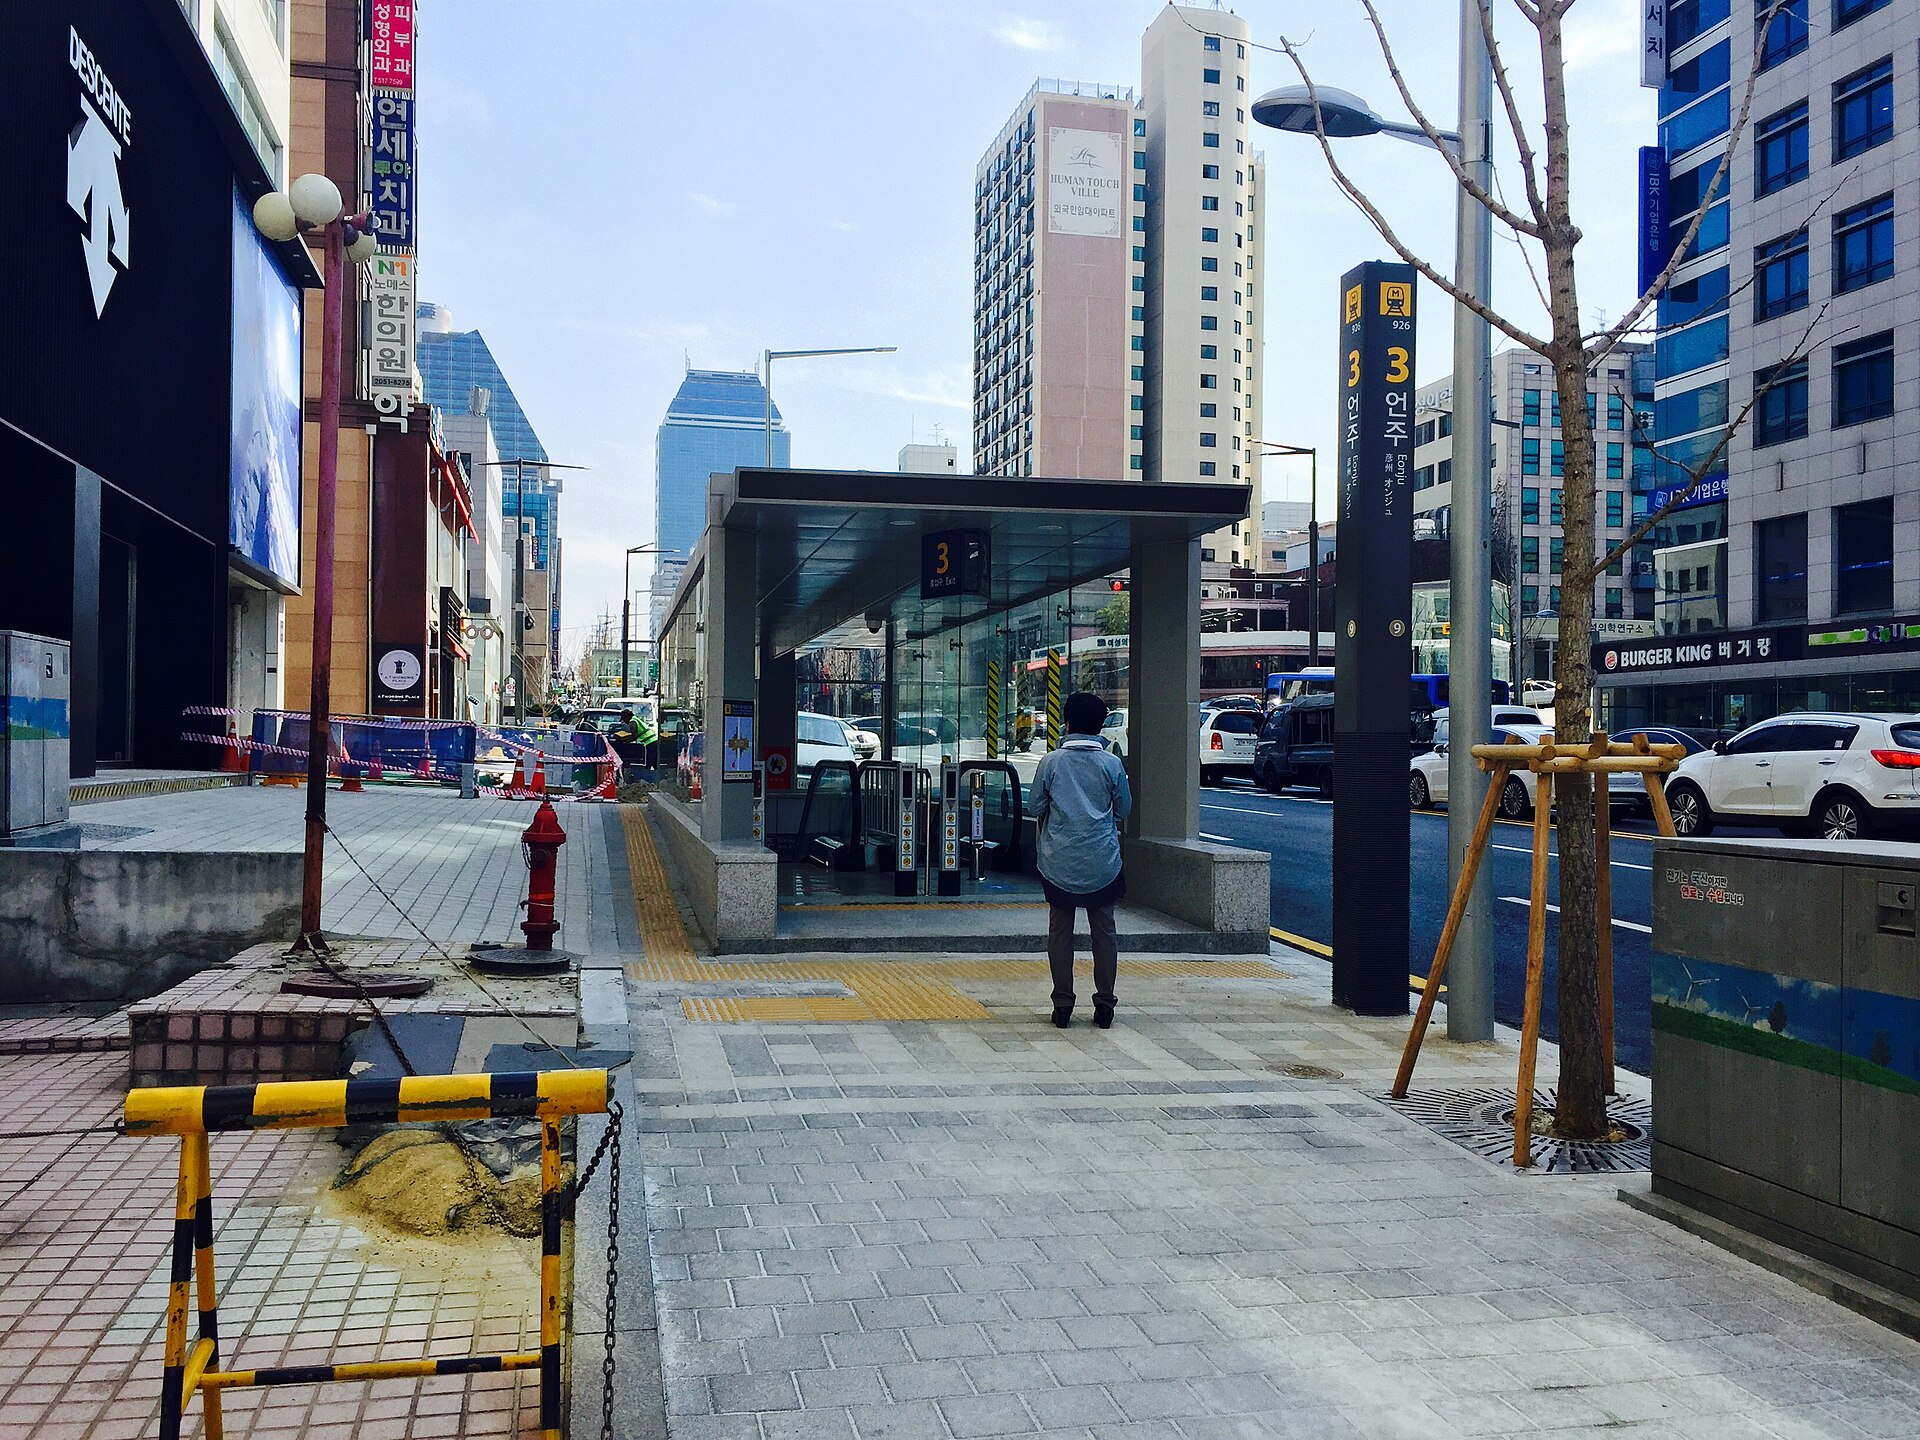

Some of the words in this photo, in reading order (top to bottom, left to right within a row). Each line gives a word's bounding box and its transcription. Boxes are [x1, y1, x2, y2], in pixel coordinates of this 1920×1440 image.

[374, 3, 391, 73] 성형외과
[394, 5, 411, 75] 피부과
[1647, 5, 1663, 59] 서치
[69, 24, 132, 146] DESCENTE
[1050, 174, 1085, 186] HUMAN
[1087, 177, 1120, 189] TOUCH
[1071, 187, 1100, 198] VILLE
[1649, 172, 1660, 196] IBK
[1053, 203, 1116, 219] 외국인임대아파트
[376, 294, 409, 374] 한의원
[1351, 321, 1361, 335] 926
[1392, 320, 1411, 331] 926
[1347, 349, 1361, 388] 3
[1385, 346, 1410, 384] 3
[373, 393, 415, 434] 약
[1346, 392, 1359, 450] 언주
[1383, 391, 1409, 447] 언주
[1395, 454, 1408, 485] Eonju
[936, 542, 950, 574] 3
[1393, 622, 1402, 634] 9
[1620, 647, 1673, 668] BURGER
[1676, 643, 1713, 663] KING
[1718, 637, 1772, 659] 버거킹
[1666, 868, 1689, 884] 전기는
[1691, 871, 1728, 888] 국산이지만
[1681, 885, 1704, 901] 연료는
[1706, 887, 1745, 905] 수입입니다
